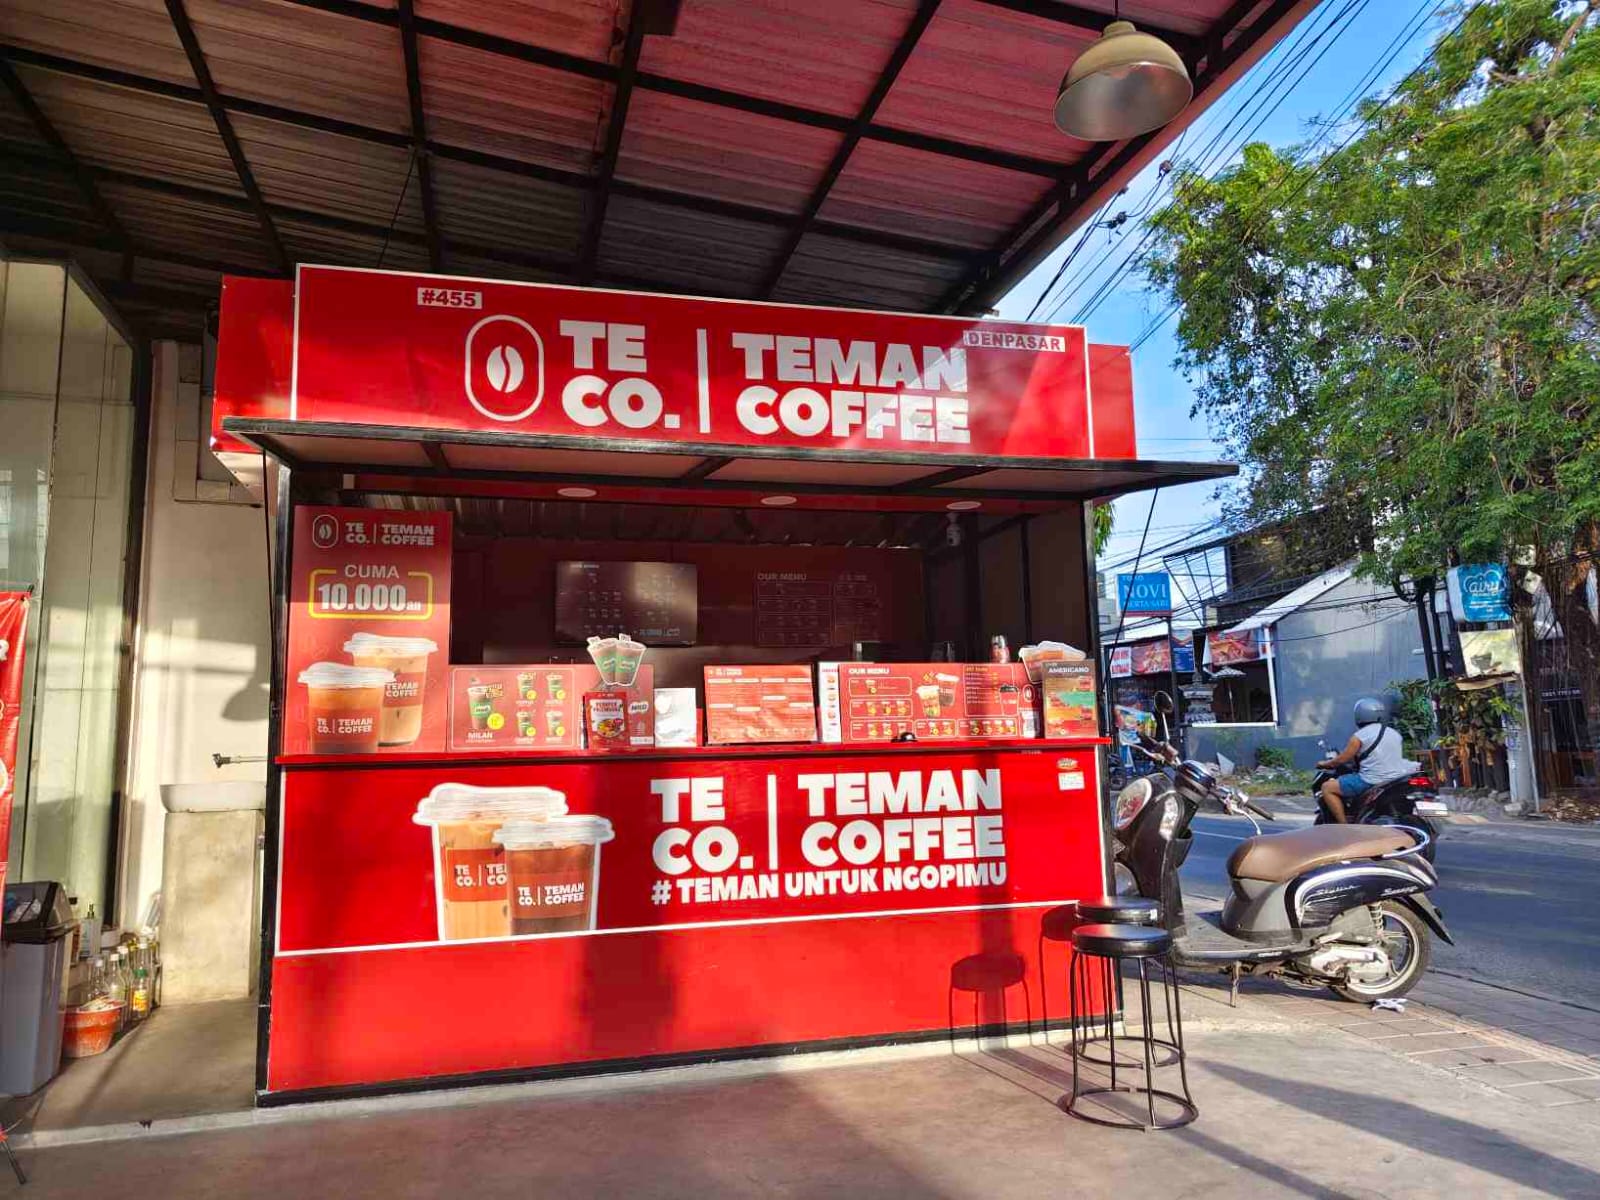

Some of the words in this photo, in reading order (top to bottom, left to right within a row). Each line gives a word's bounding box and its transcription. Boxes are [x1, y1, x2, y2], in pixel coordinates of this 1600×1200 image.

[421, 289, 477, 308] #455
[559, 319, 647, 373] TE
[966, 332, 1062, 352] DENPASAR
[732, 332, 967, 393] TEMAN
[561, 374, 681, 429] CO.
[735, 384, 971, 443] COFFEE
[345, 522, 364, 533] TE
[381, 523, 435, 535] TEMAN
[345, 533, 370, 545] CO.
[381, 534, 435, 546] COFFEE
[344, 564, 400, 579] CUMA
[1123, 583, 1167, 599] NOVI
[317, 717, 327, 726] TE
[338, 717, 373, 727] TEMAN
[338, 725, 373, 734] COFFEE
[650, 775, 726, 823] TE
[797, 768, 1003, 817] TEMAN
[800, 815, 1006, 868] COFFEE
[652, 825, 755, 876] CO.
[454, 864, 470, 875] TE
[784, 867, 880, 898] UNTUK
[882, 861, 1008, 892] NGOPIMU
[518, 886, 530, 896] TE
[544, 882, 585, 896] TEMAN
[544, 894, 585, 906] COFFEE
